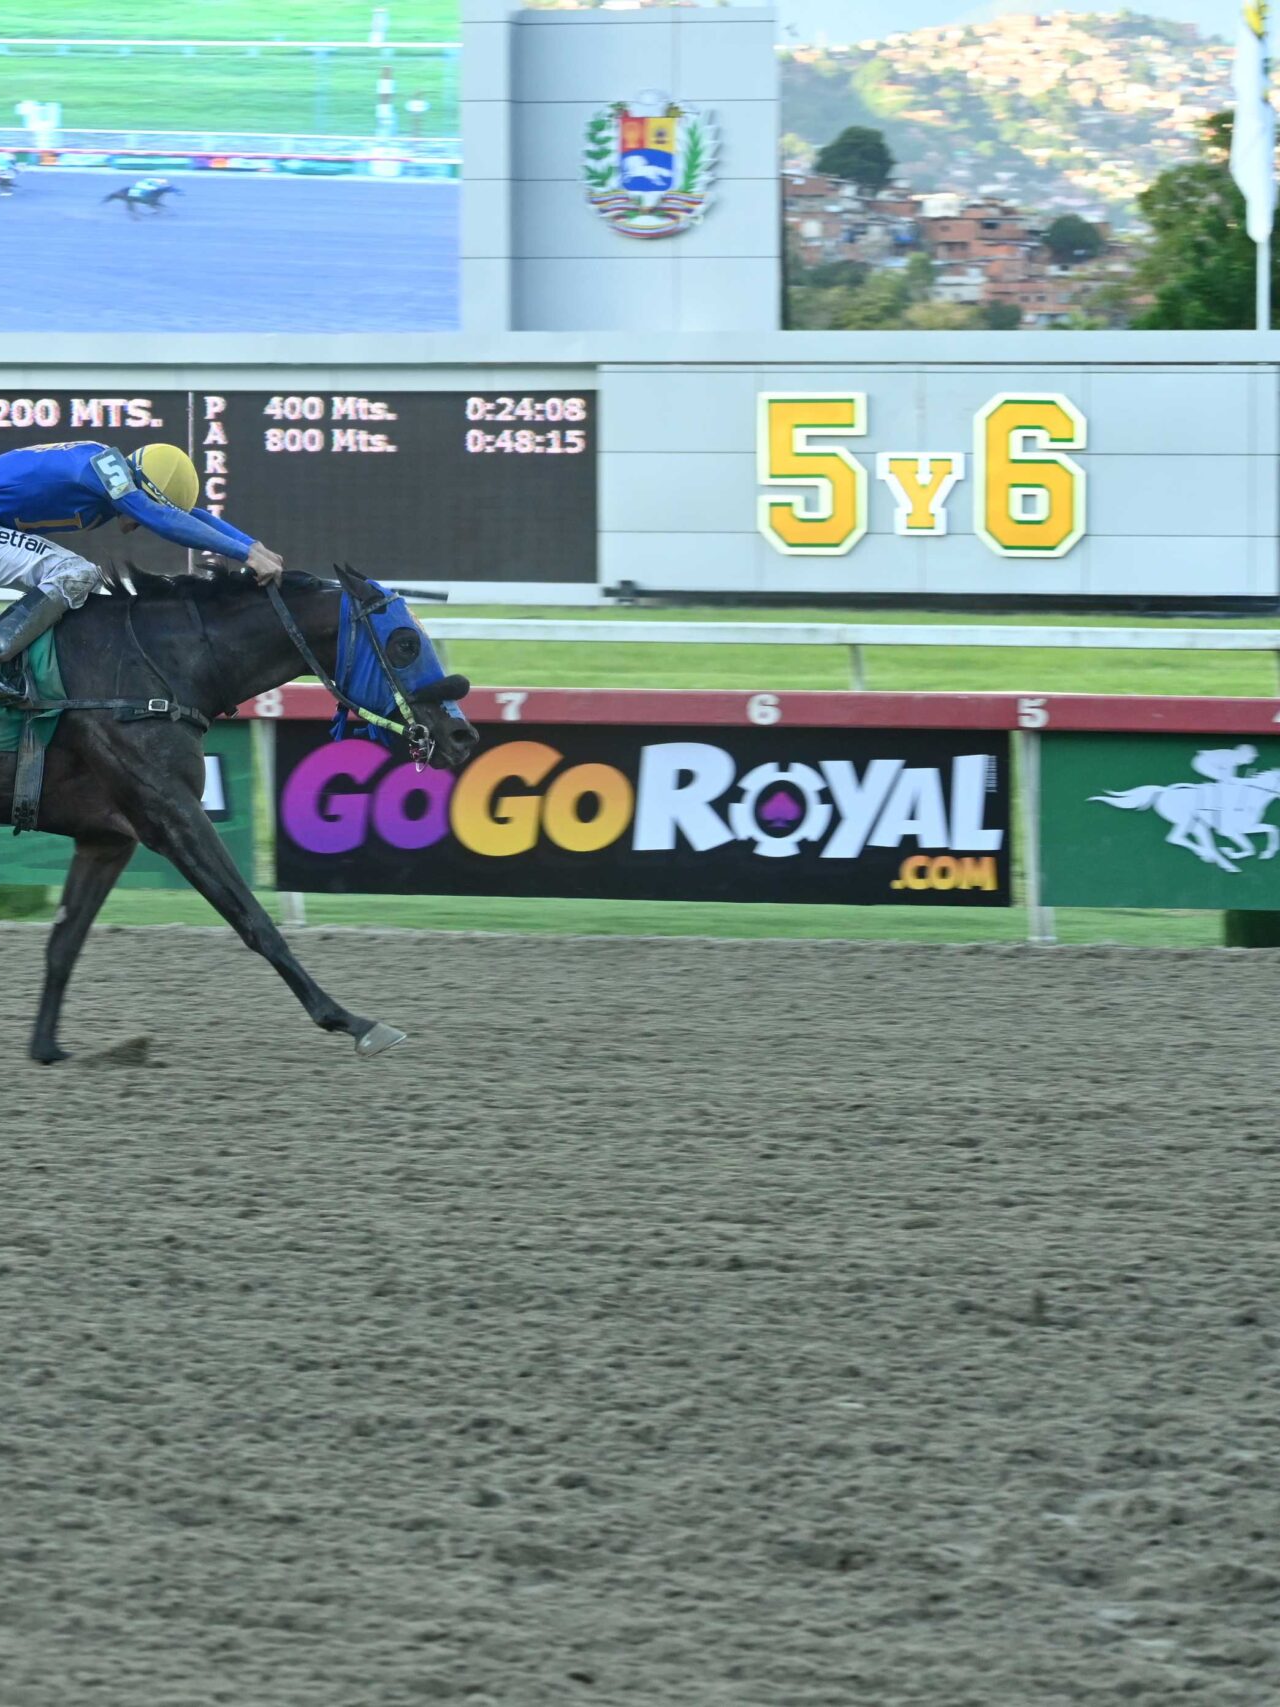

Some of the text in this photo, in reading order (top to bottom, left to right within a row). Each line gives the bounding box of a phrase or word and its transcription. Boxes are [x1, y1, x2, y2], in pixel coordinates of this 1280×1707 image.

[70, 398, 163, 428] MTS.
[263, 396, 587, 422] 400 Mts. 0:24:08
[264, 428, 587, 454] 800 Mts. 0:48:15
[97, 454, 129, 487] 5
[757, 391, 868, 556] 5
[973, 392, 1087, 558] 6
[255, 688, 283, 717] 8
[496, 691, 527, 721] 7
[746, 693, 782, 725] 6
[1017, 697, 1050, 728] 5
[891, 854, 998, 891] .COM
